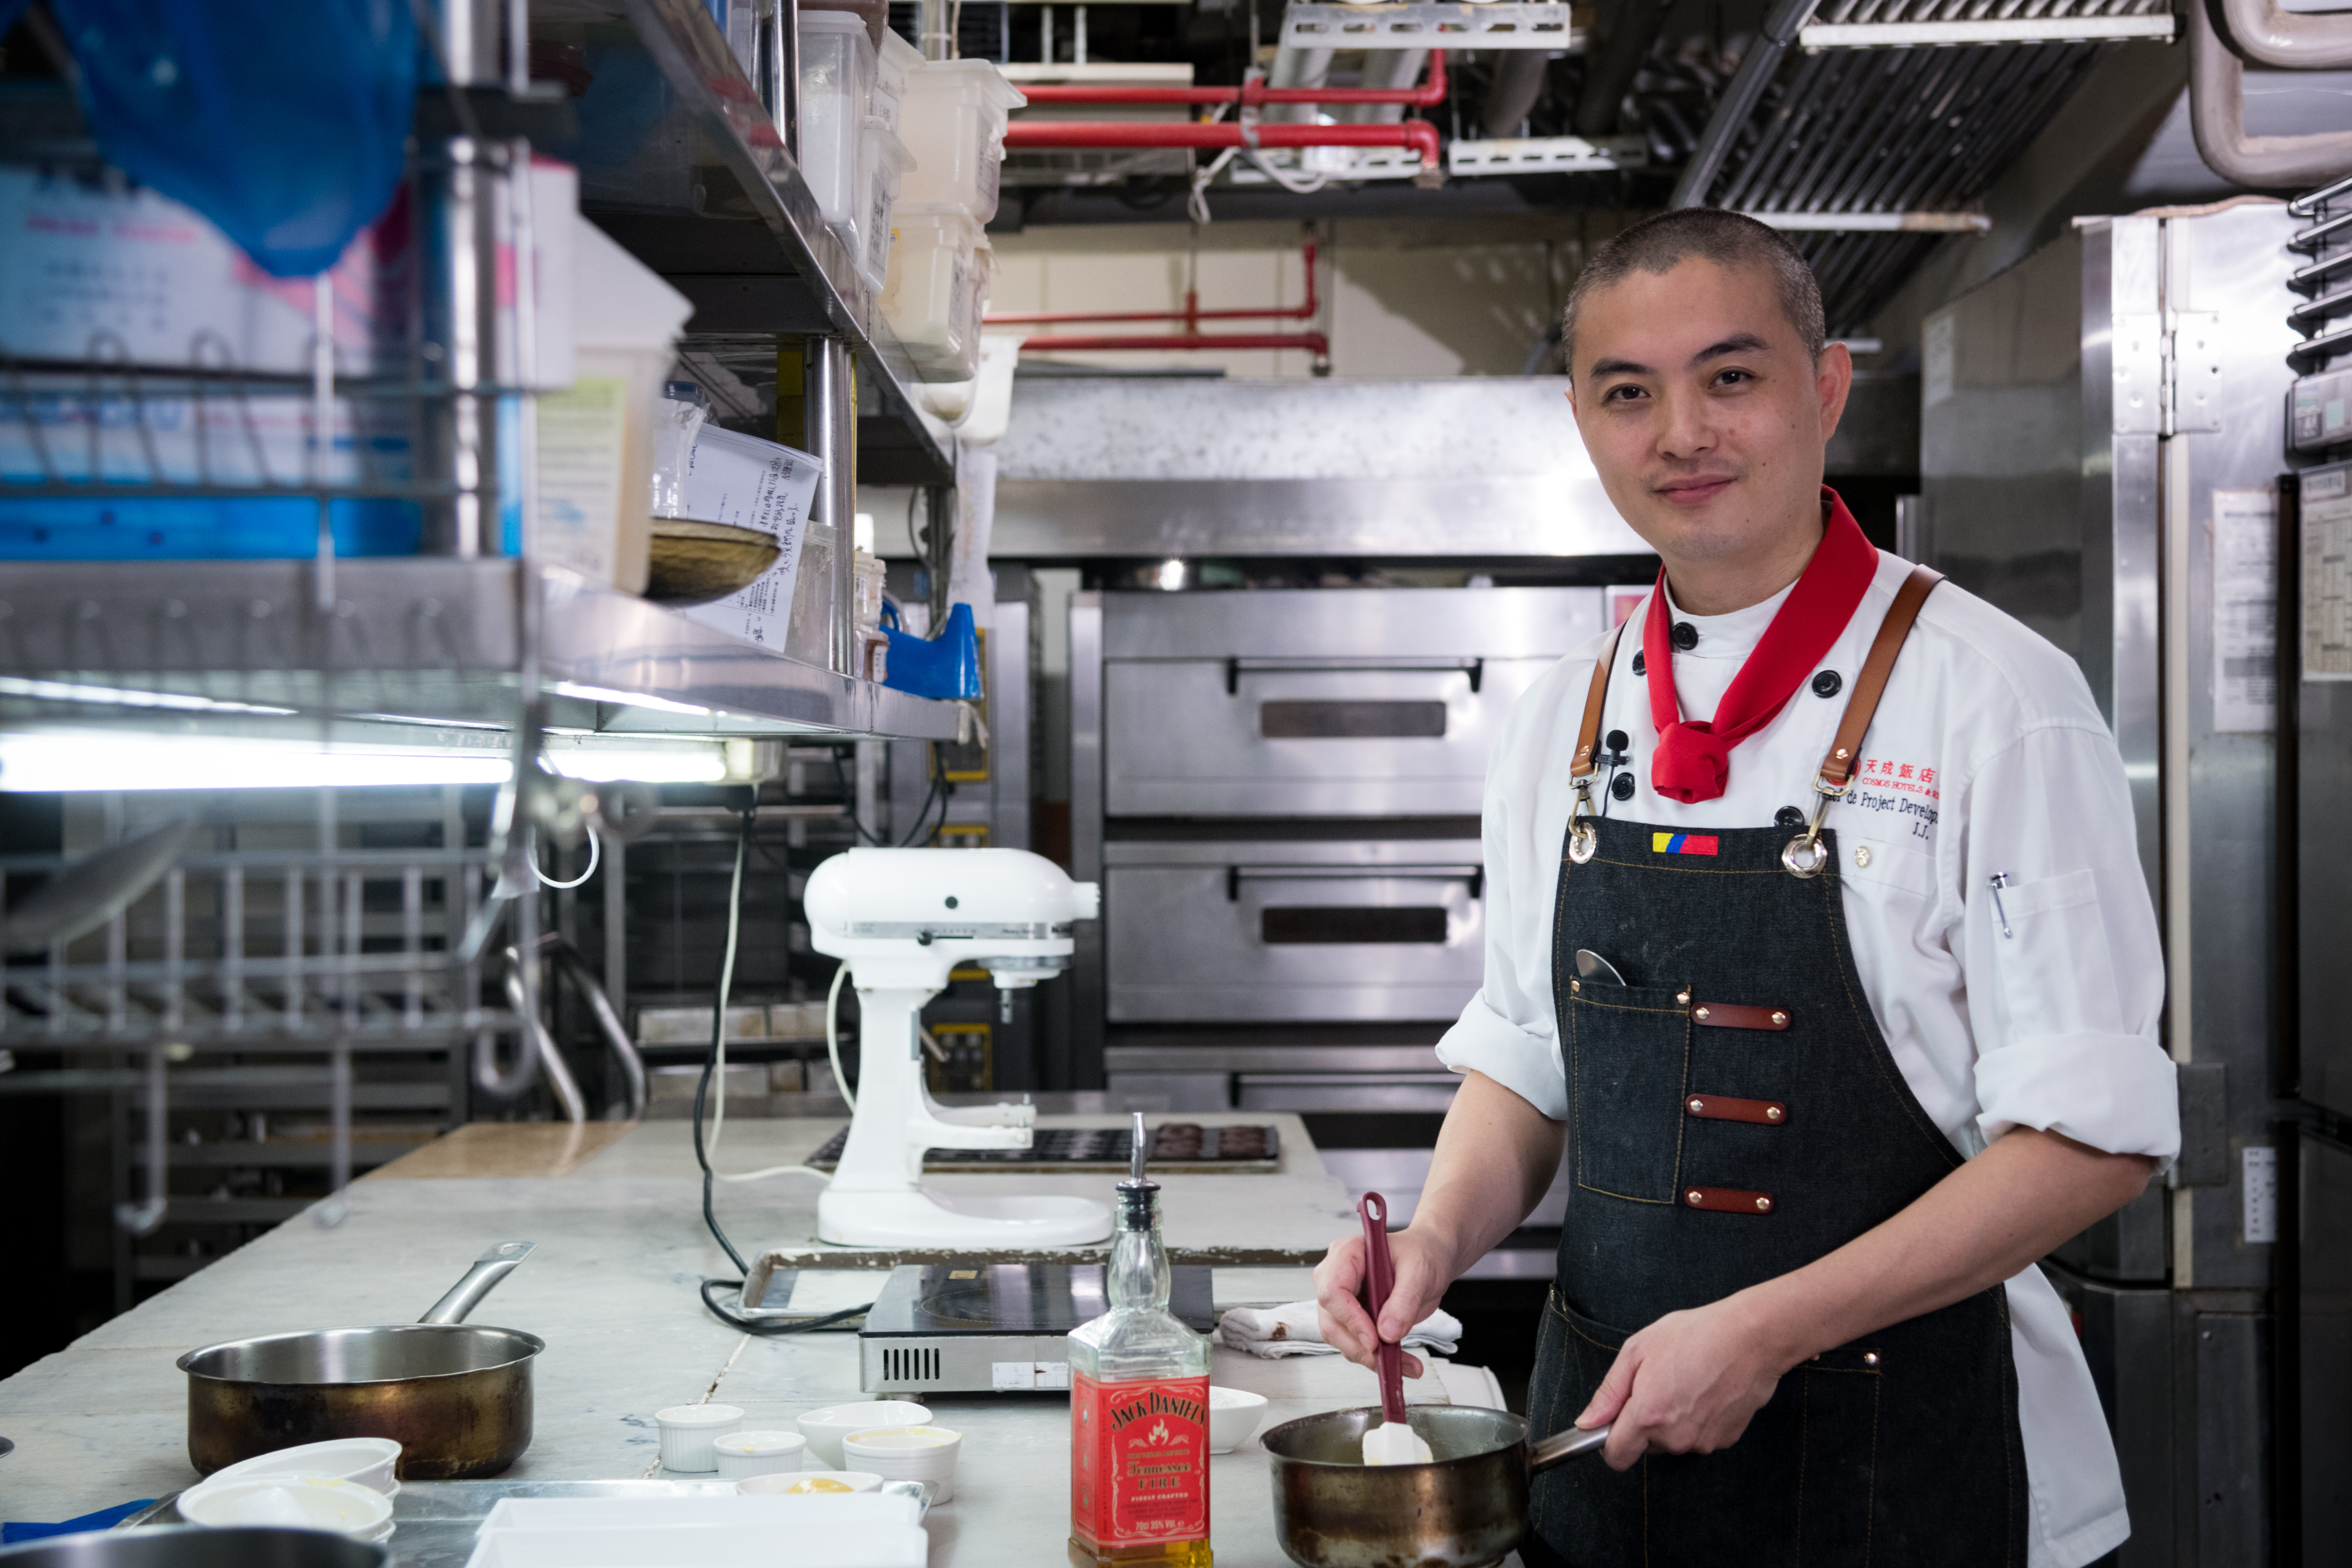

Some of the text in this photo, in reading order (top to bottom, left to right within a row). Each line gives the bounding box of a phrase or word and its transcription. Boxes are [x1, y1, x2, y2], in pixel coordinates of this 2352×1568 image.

[1864, 759, 1936, 783] 天成飯店
[1862, 777, 1891, 788] COSMOS
[1892, 781, 1923, 794] HOTELS
[1925, 788, 1931, 796] &
[1847, 790, 1857, 805] de
[1860, 792, 1896, 812] Project
[1111, 1391, 1206, 1432] JACK DANIEL'S
[1127, 1461, 1191, 1477] Tennessee
[1138, 1476, 1181, 1491] FIRE
[1157, 1492, 1189, 1500] CRAFTED
